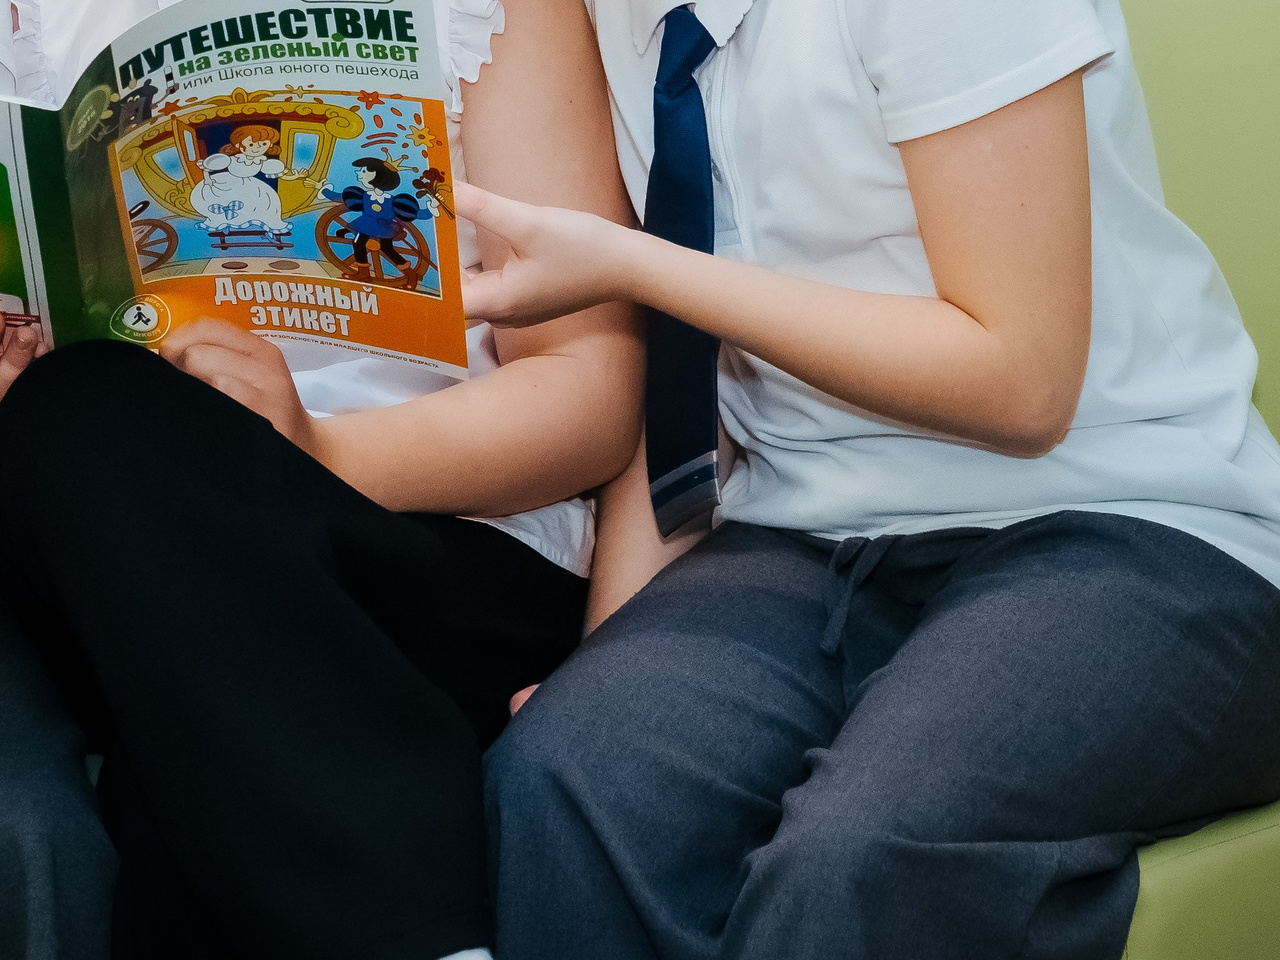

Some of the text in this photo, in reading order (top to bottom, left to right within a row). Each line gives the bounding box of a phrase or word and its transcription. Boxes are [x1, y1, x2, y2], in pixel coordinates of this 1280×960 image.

[119, 7, 418, 90] ПУТЕШЕСТВИЕ
[178, 34, 419, 77] на зеленый свет
[183, 62, 419, 90] или Школа юного пешехода
[214, 277, 380, 316] Дорожный
[249, 304, 351, 337] этикет
[270, 333, 319, 344] БЕЗОПАСНОСТИ
[333, 343, 369, 353] МЛАДШЕГО
[370, 350, 408, 362] ШКОЛЬНОГО
[408, 357, 440, 369] ВОЗРАСТА
